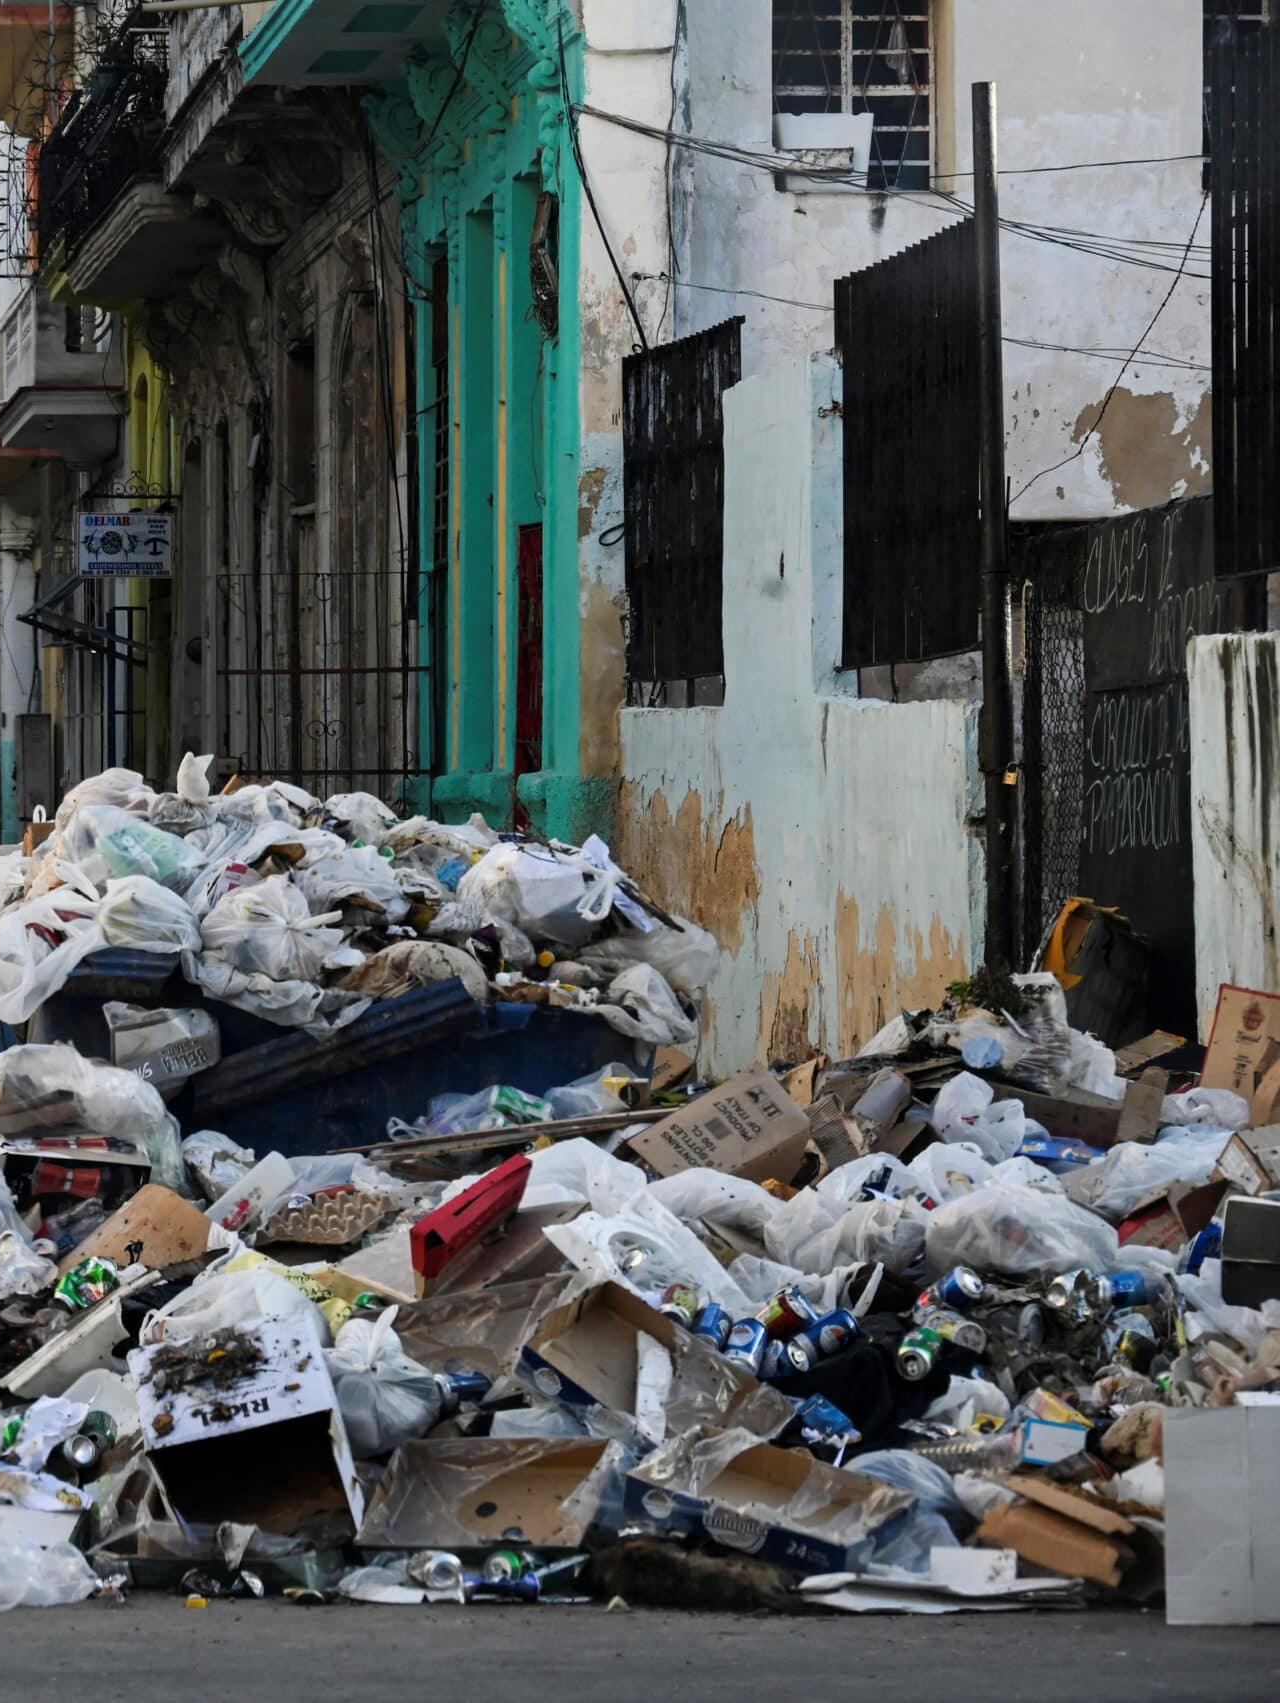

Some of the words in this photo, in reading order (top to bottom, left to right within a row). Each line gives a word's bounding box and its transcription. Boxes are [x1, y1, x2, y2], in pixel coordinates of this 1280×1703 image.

[85, 516, 130, 526] DELMAR
[724, 1096, 751, 1121] ITALY
[712, 1101, 753, 1142] PRODUCT
[746, 1119, 761, 1134] OF
[670, 1123, 710, 1161] BOTTLES
